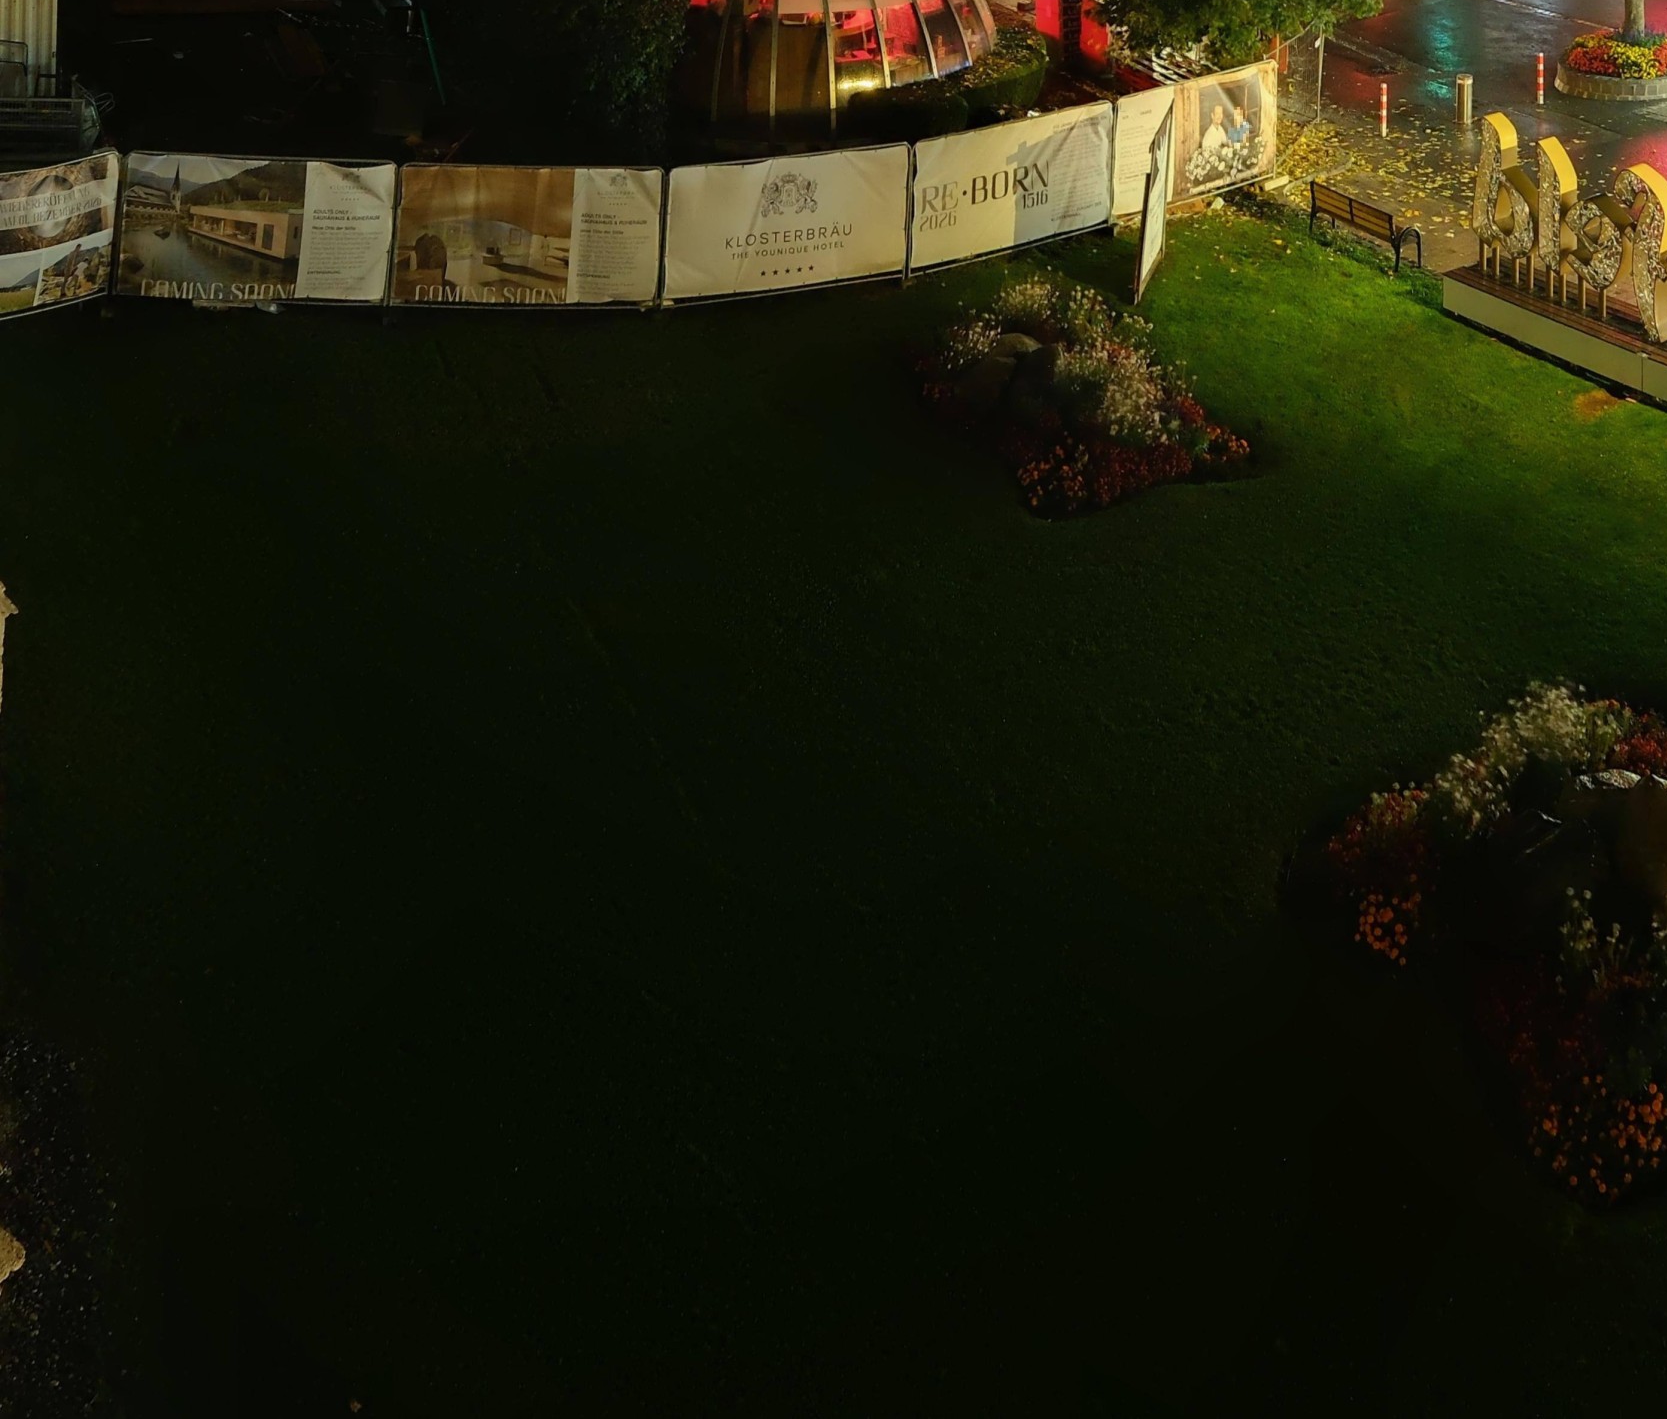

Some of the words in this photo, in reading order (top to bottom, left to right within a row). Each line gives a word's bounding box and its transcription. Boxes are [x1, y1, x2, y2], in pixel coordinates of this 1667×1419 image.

[1022, 189, 1048, 209] 1516
[919, 211, 957, 232] 2026
[725, 222, 853, 249] KLOSTERBRÄU
[731, 251, 749, 260] THE
[754, 245, 808, 257] YOUNIQUE
[813, 241, 845, 251] HOTEL
